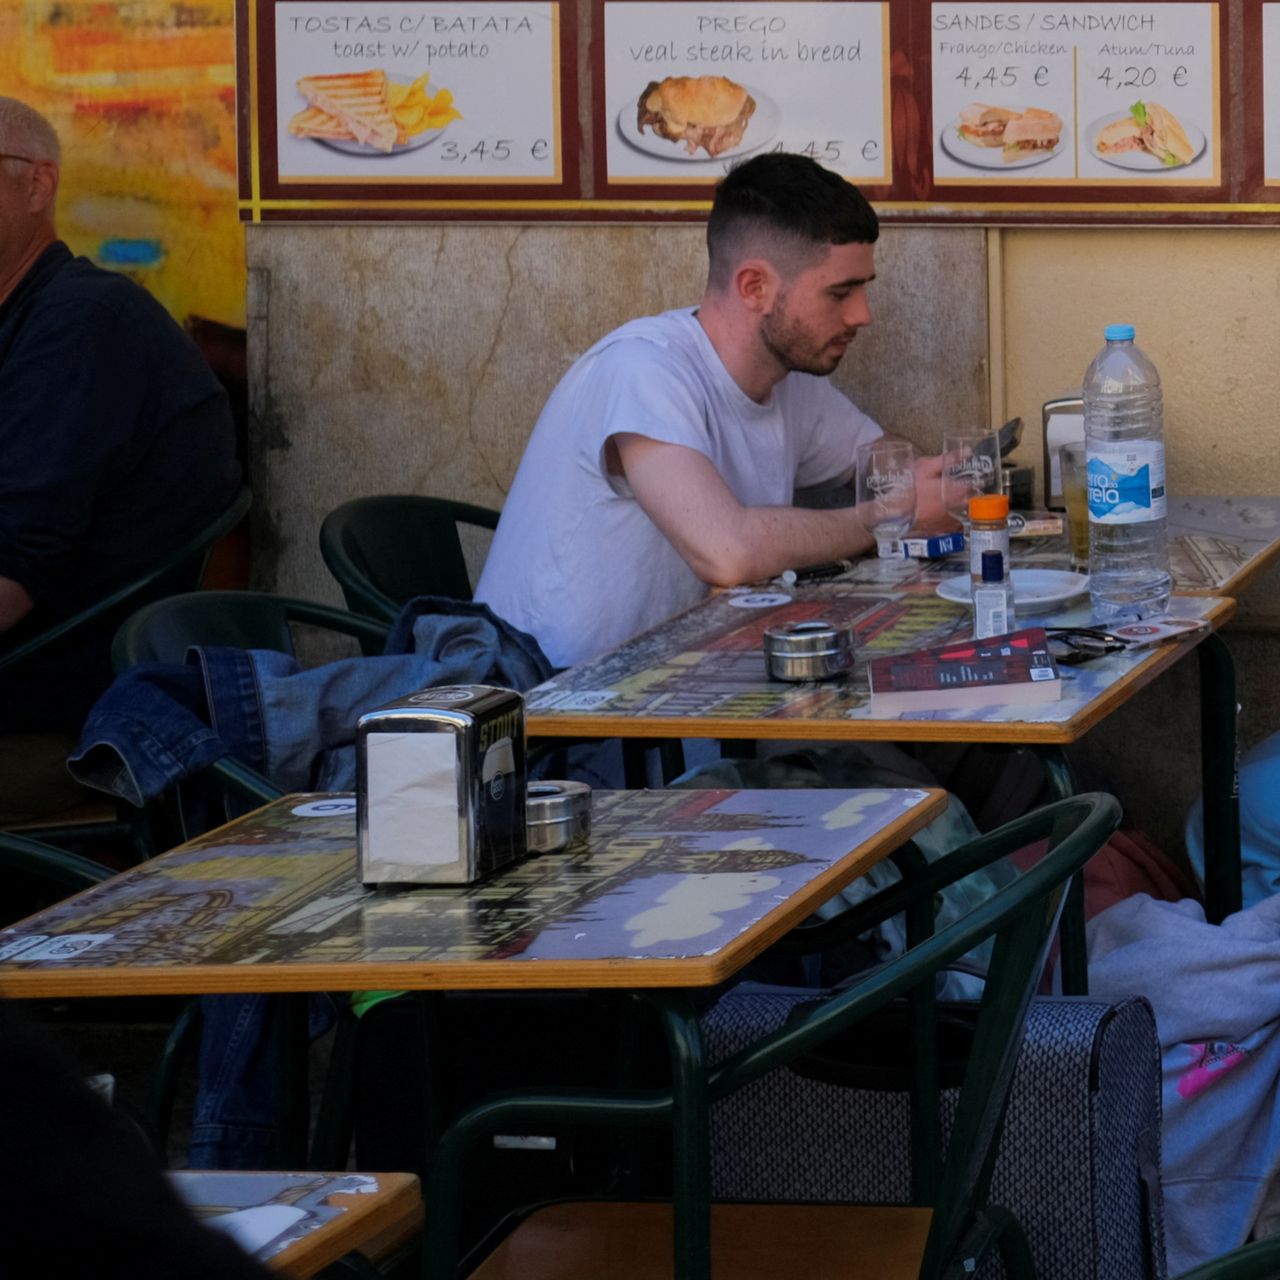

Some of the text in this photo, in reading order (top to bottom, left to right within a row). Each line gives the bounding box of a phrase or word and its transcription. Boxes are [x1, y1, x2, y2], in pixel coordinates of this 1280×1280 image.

[290, 16, 531, 32] TOSTAS BATATA
[697, 16, 785, 35] PREGO
[933, 14, 1153, 31] SANDES SANDWICH
[334, 40, 488, 64] toast potato
[630, 40, 861, 62] veal steak bread
[956, 67, 1156, 89] 4,45 4,20
[441, 140, 510, 163] 3,45
